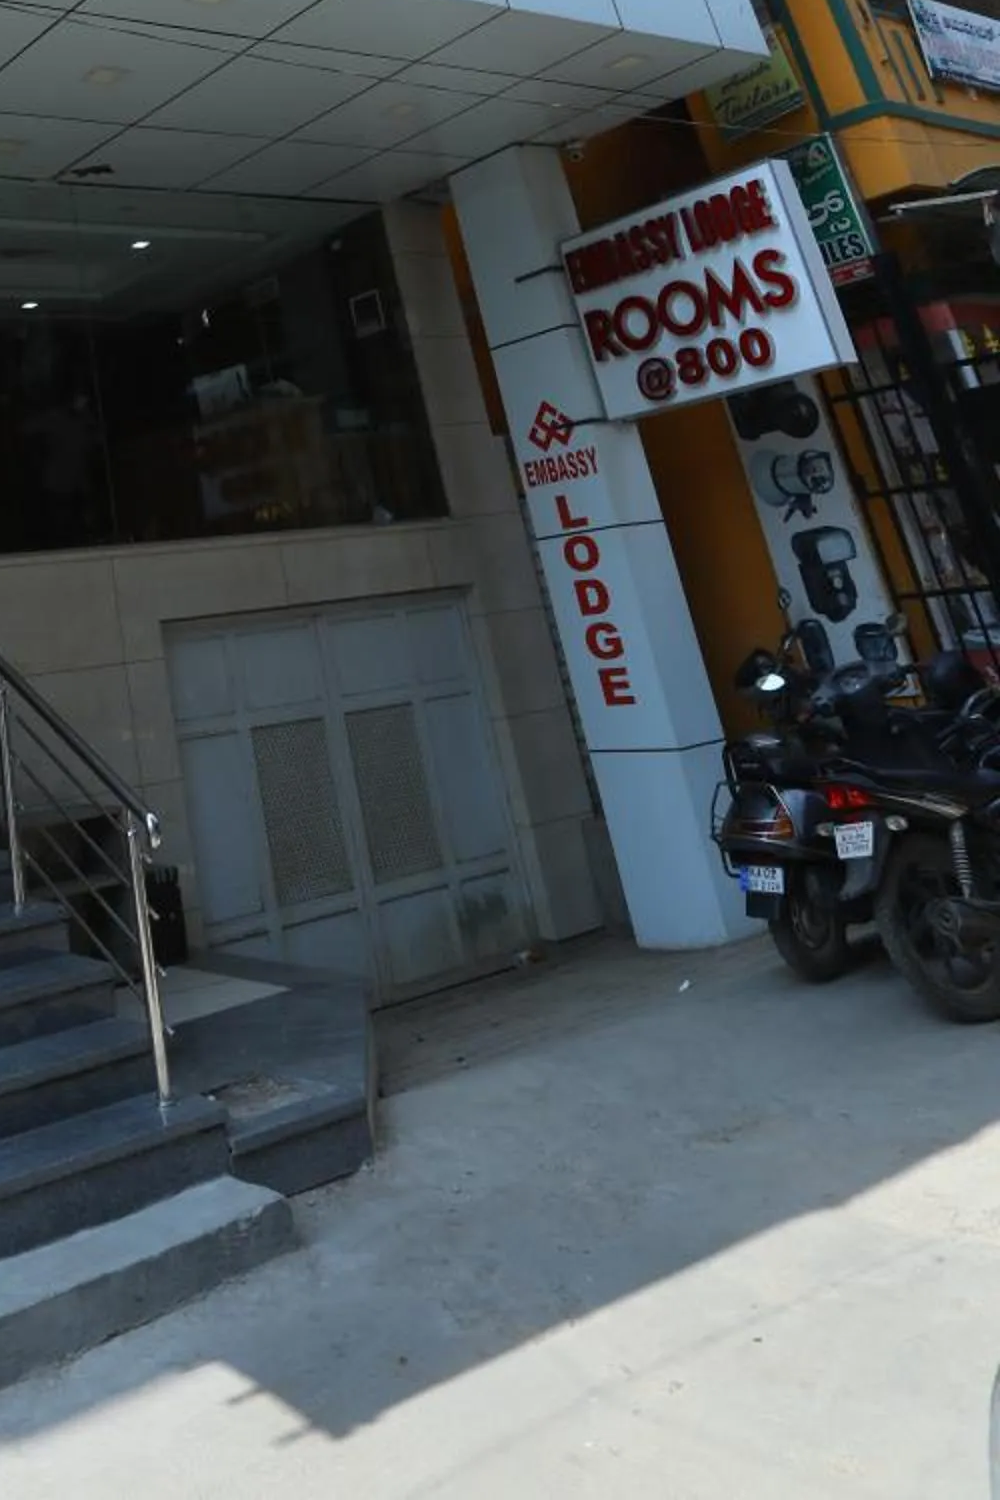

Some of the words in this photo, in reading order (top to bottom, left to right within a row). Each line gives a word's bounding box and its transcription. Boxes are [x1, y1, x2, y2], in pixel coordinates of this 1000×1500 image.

[564, 211, 684, 294] EMBASSY
[679, 179, 779, 254] LODGE
[583, 249, 798, 364] ROOMS
[637, 327, 775, 402] @800
[524, 446, 599, 488] EMBASSY
[555, 495, 636, 707] LODGE
